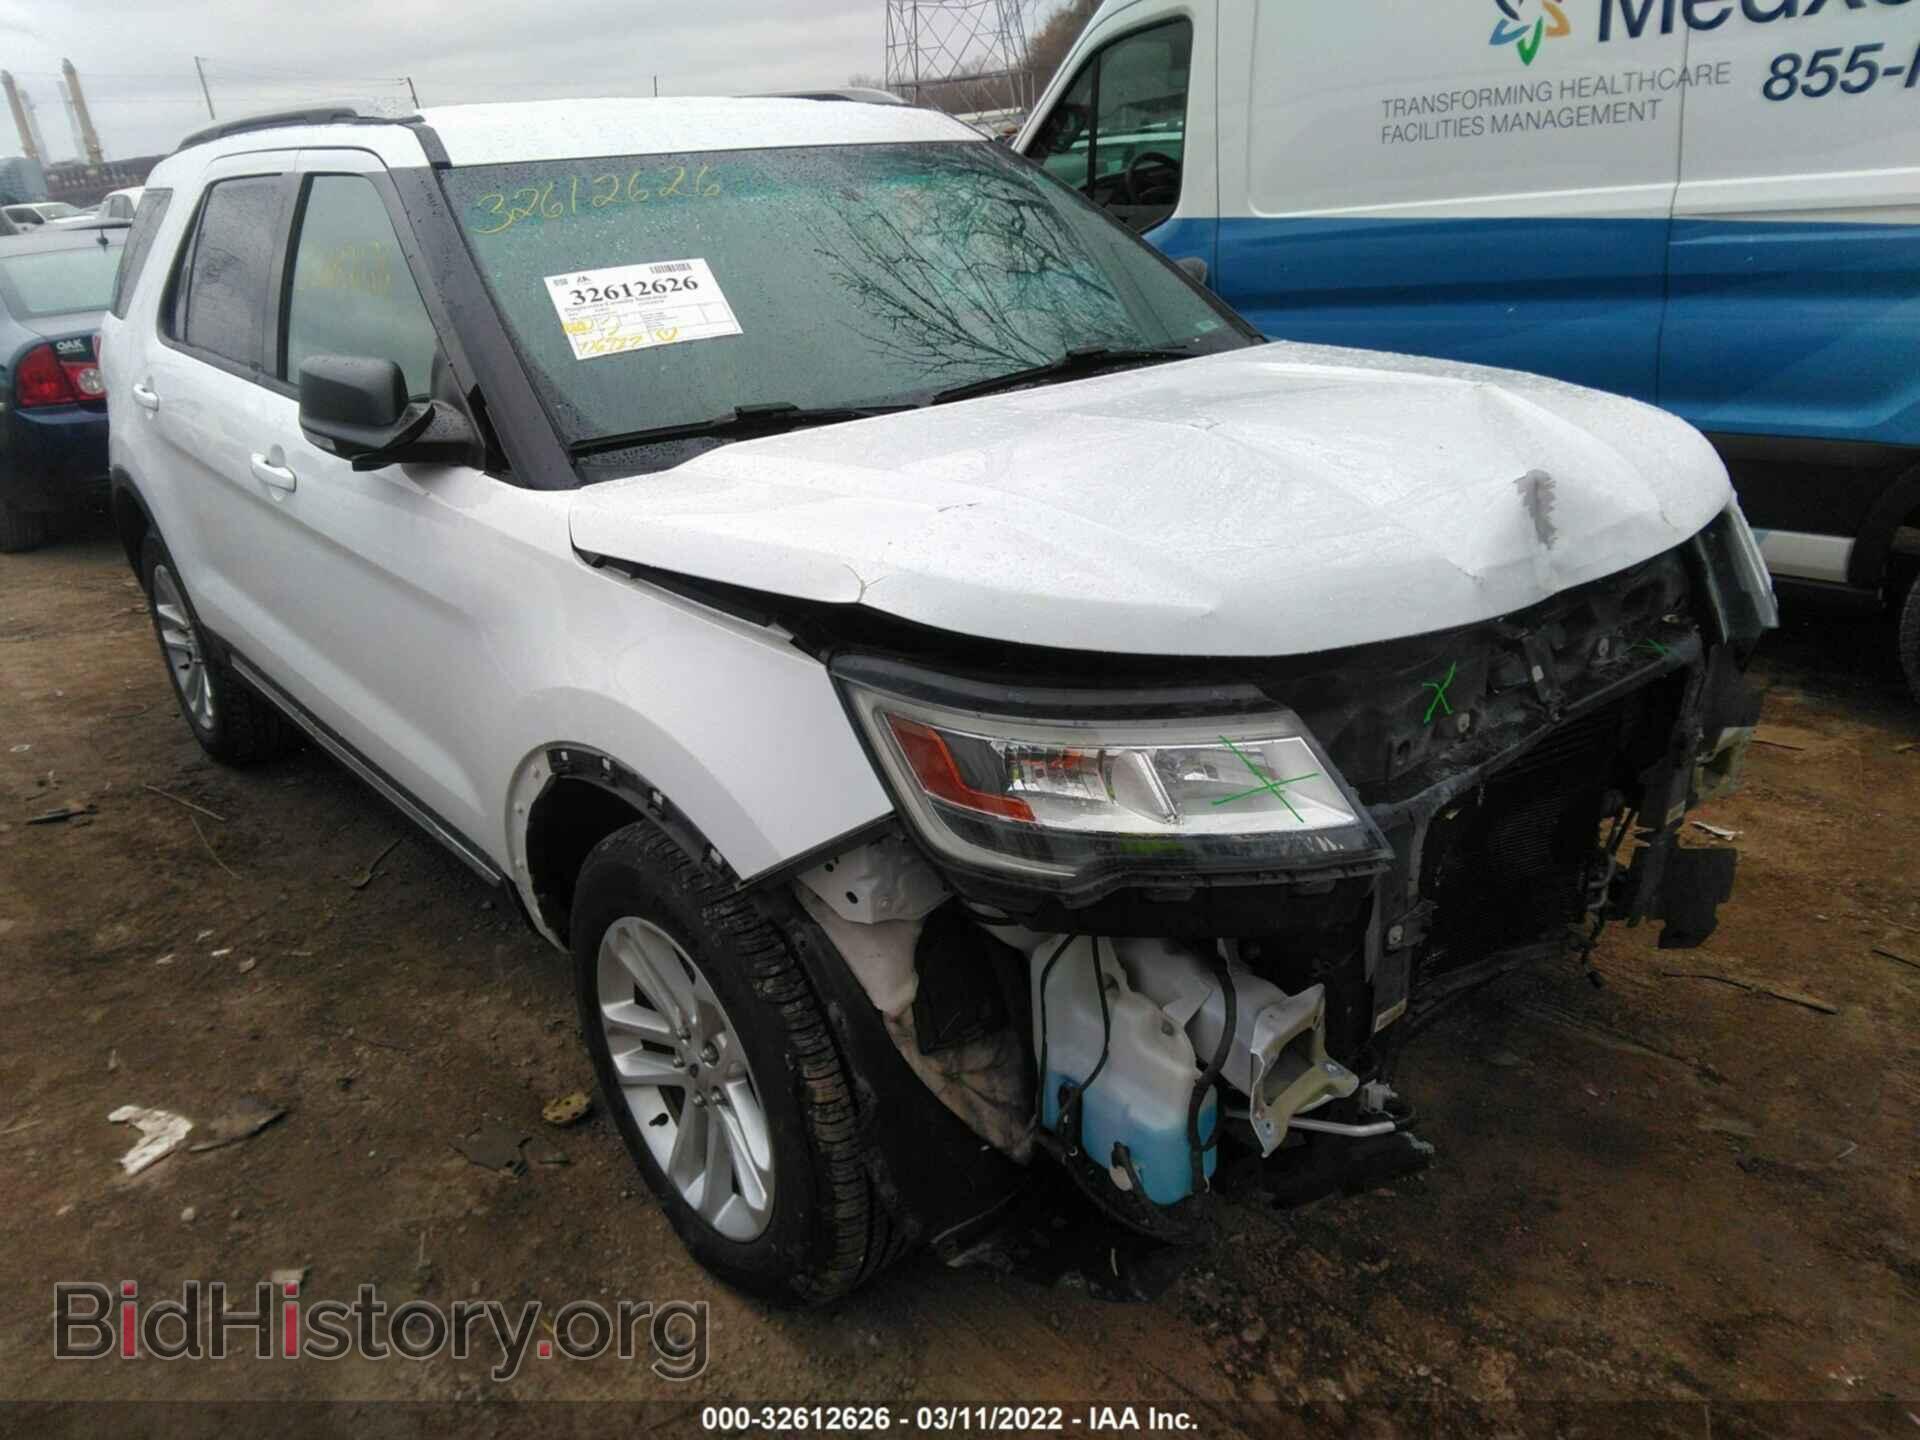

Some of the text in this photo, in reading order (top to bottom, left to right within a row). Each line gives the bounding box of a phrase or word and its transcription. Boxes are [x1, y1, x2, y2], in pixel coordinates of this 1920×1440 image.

[1381, 61, 1732, 119] TRANSFORMING HEALTHCARE
[1381, 99, 1662, 145] FACILITIES MANAGEMENT
[471, 165, 721, 235] 32612626
[569, 275, 699, 306] 32612626
